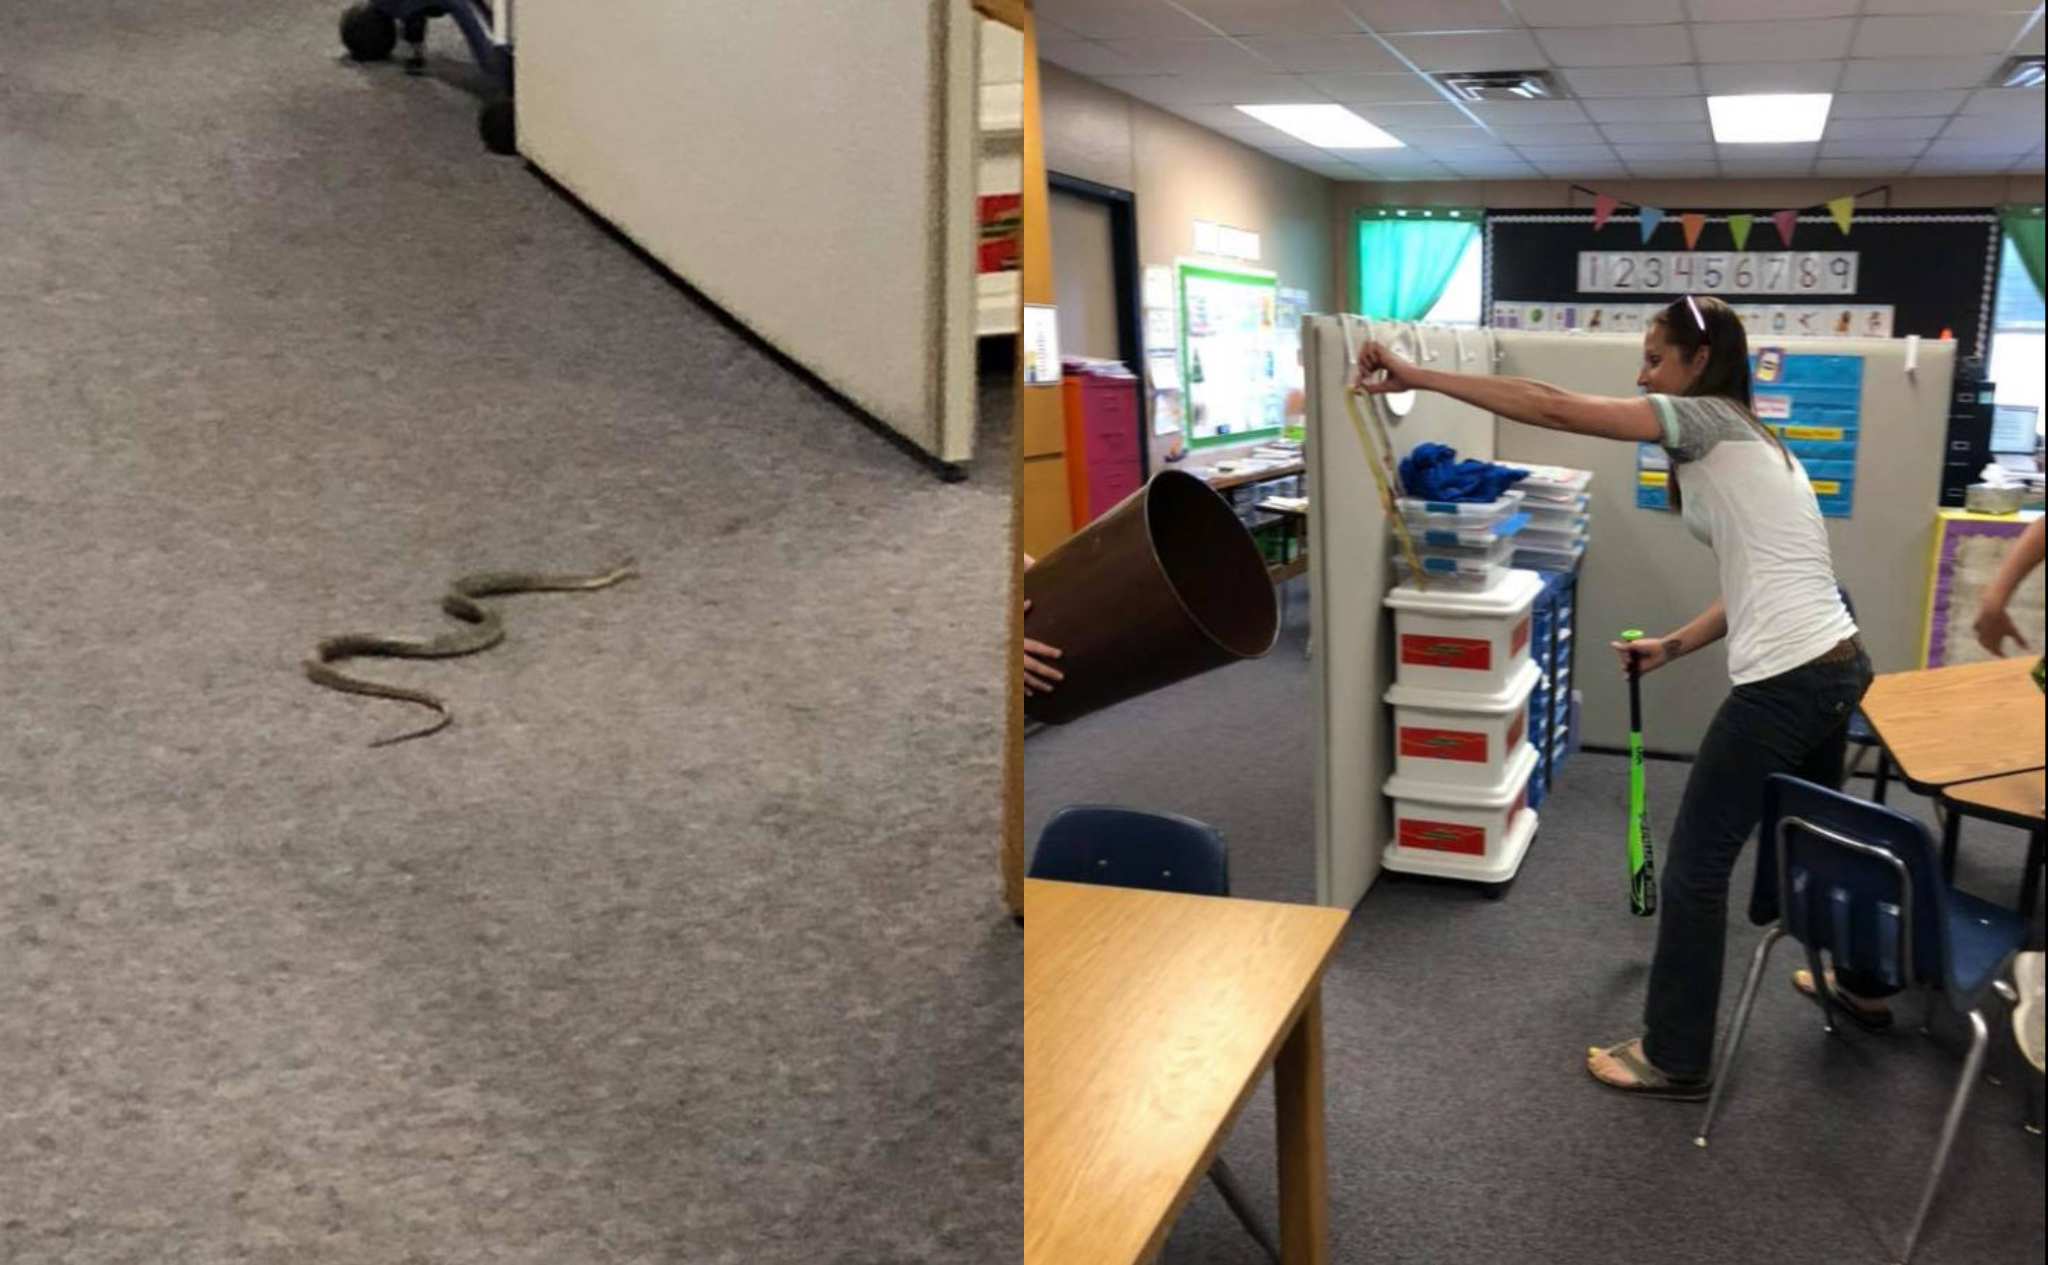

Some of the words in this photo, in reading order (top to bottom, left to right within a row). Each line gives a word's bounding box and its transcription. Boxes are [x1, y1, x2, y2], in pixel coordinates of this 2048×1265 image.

[1590, 256, 1598, 287] 1
[1614, 257, 1635, 288] 2
[1642, 257, 1663, 289] 3
[1674, 255, 1693, 289] 4
[1704, 257, 1724, 289] 5
[1734, 257, 1753, 289] 6
[1768, 258, 1785, 290] 7
[1798, 257, 1818, 289] 8
[1829, 257, 1850, 290] 9
